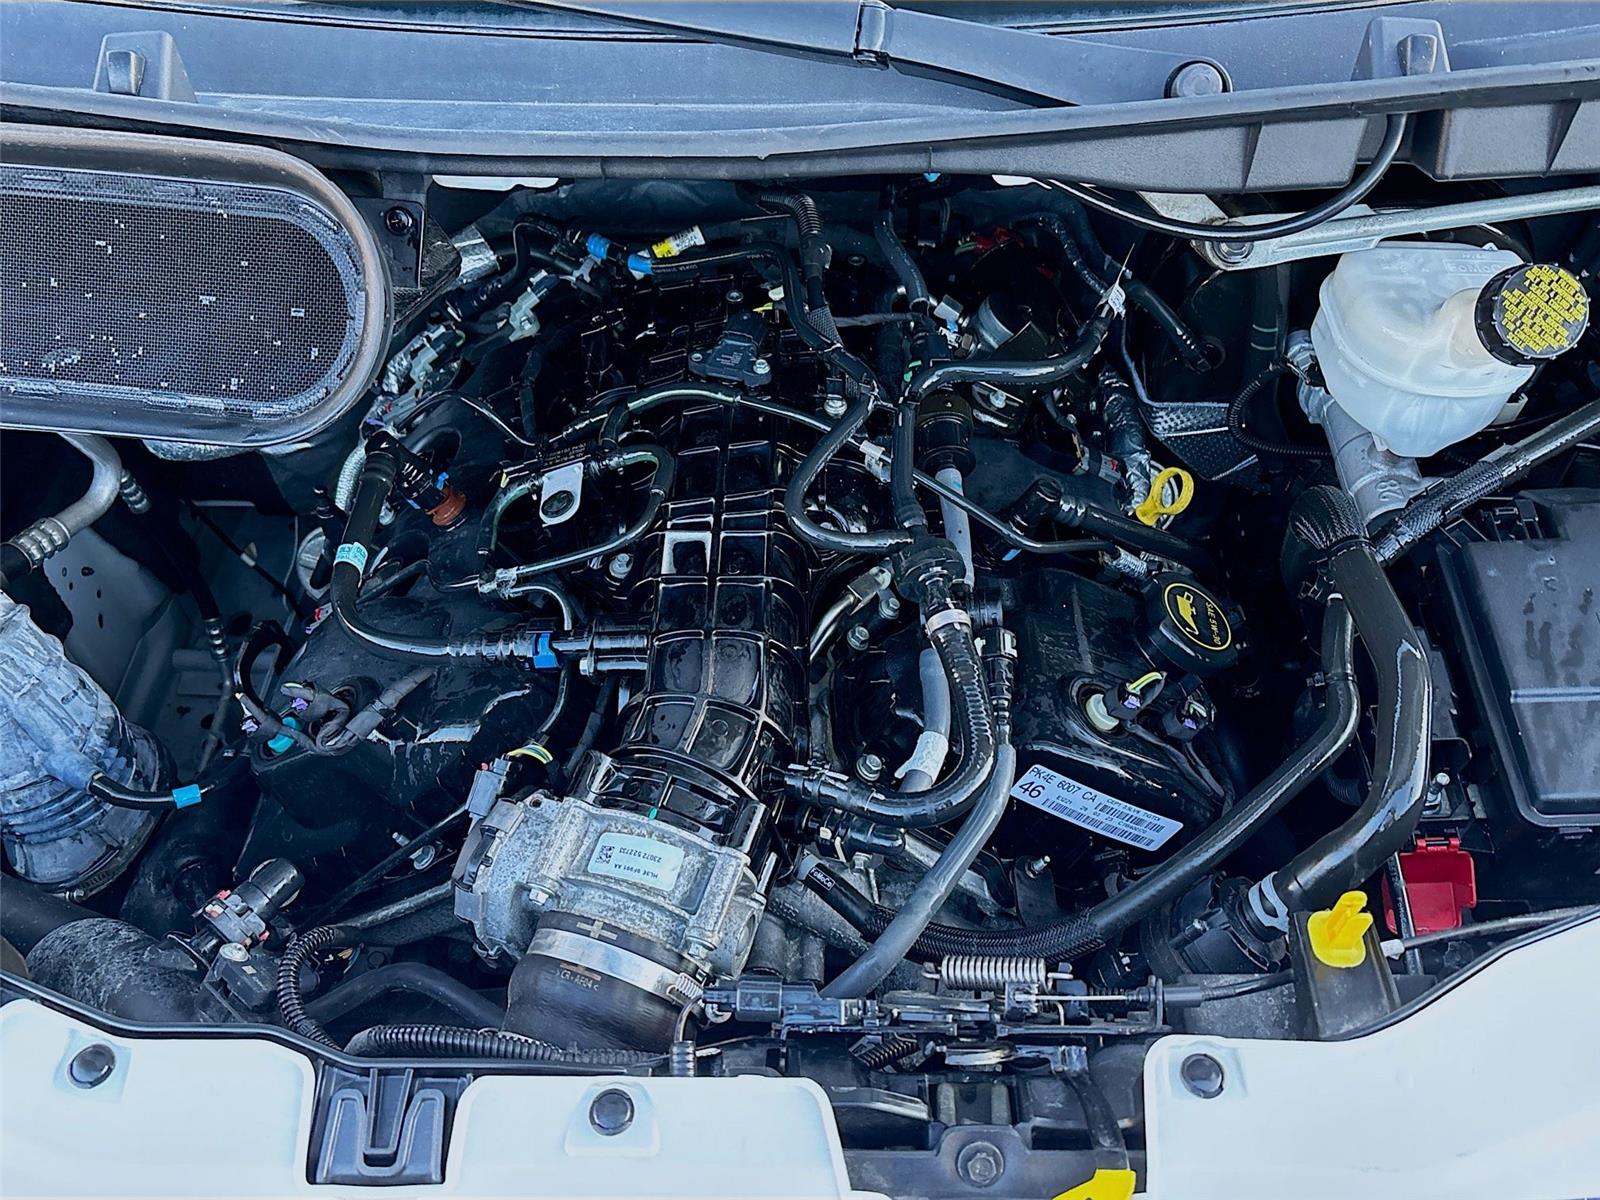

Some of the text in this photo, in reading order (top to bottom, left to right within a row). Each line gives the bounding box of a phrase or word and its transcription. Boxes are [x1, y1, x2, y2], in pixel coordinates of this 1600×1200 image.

[1376, 479, 1405, 502] 28
[1018, 781, 1046, 799] 46
[1028, 766, 1097, 803] PK4E 6007 CA
[810, 867, 832, 887] FoMoCo
